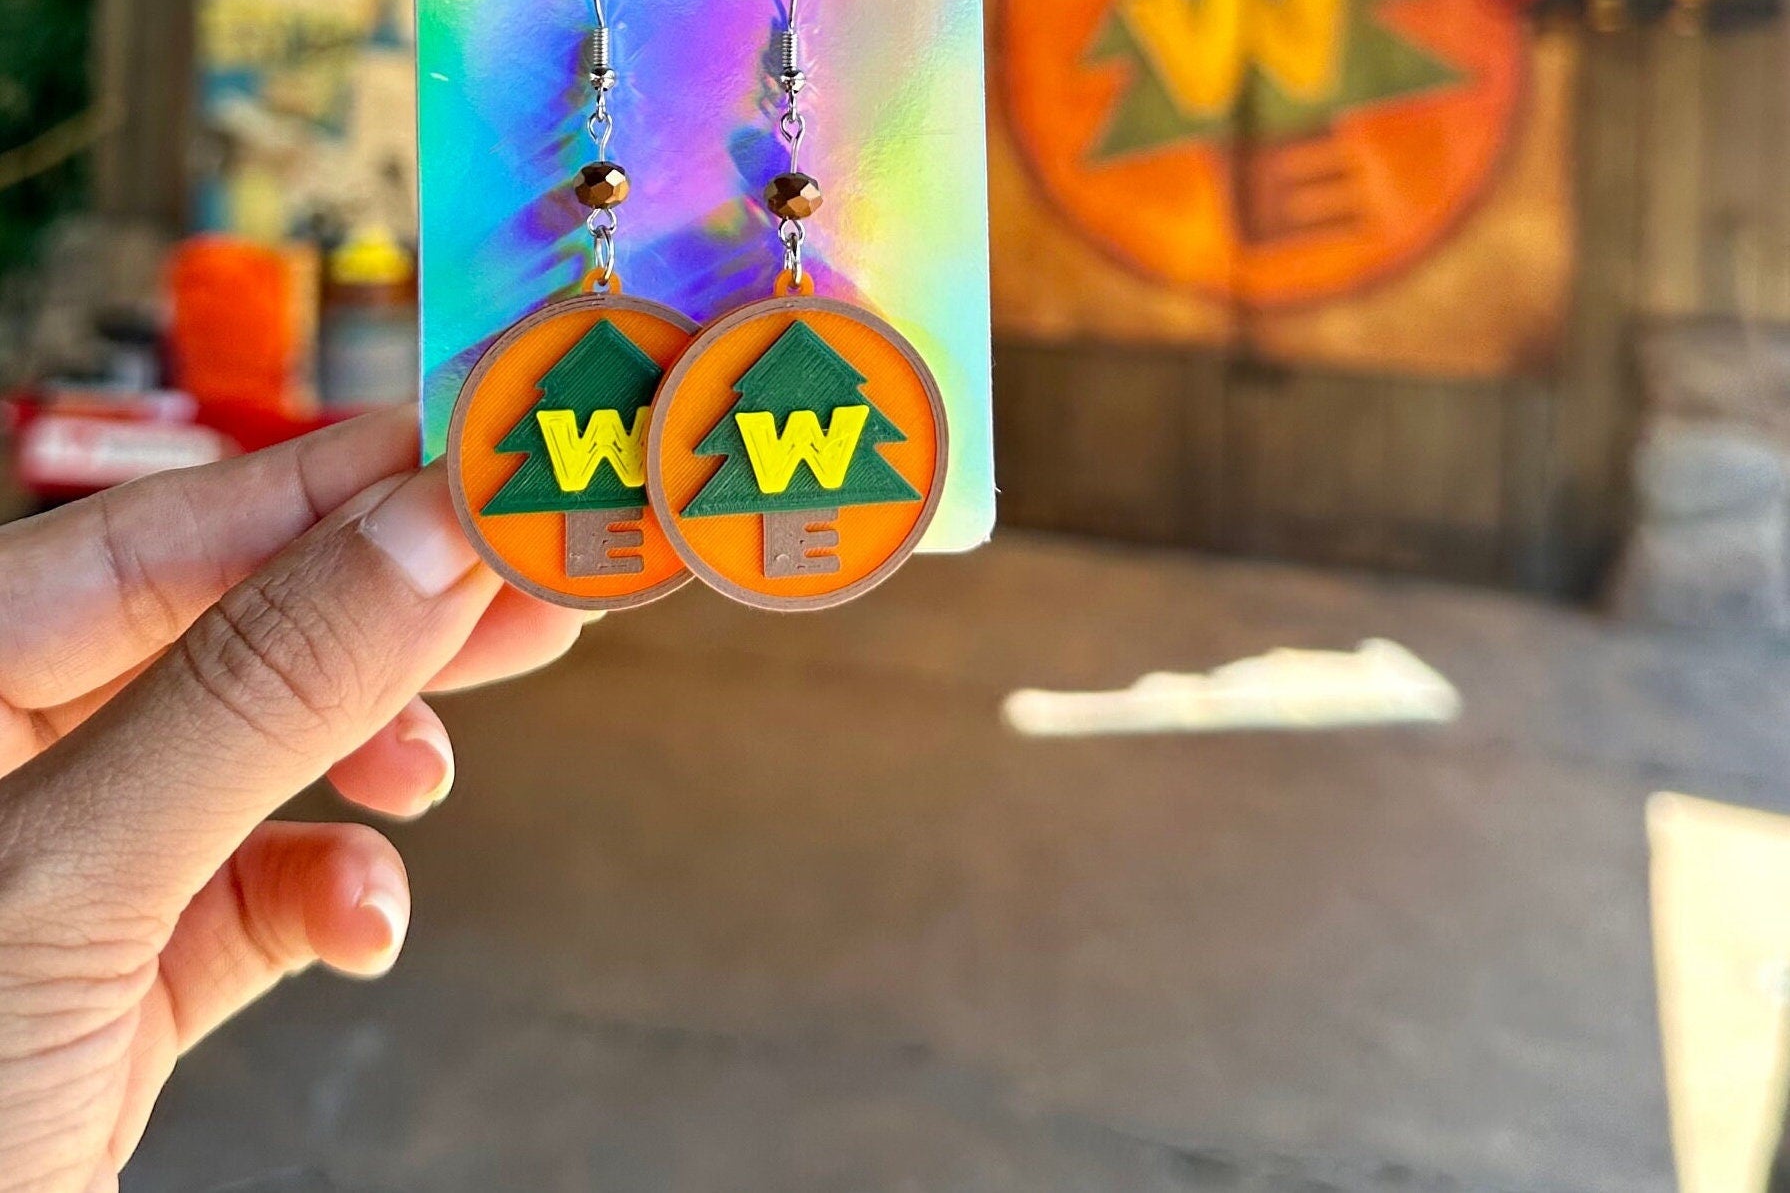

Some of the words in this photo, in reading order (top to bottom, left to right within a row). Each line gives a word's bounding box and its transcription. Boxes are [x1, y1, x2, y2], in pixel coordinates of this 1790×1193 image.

[536, 406, 649, 493] W
[735, 404, 870, 494] W
[565, 508, 645, 578] E
[763, 508, 841, 579] E
